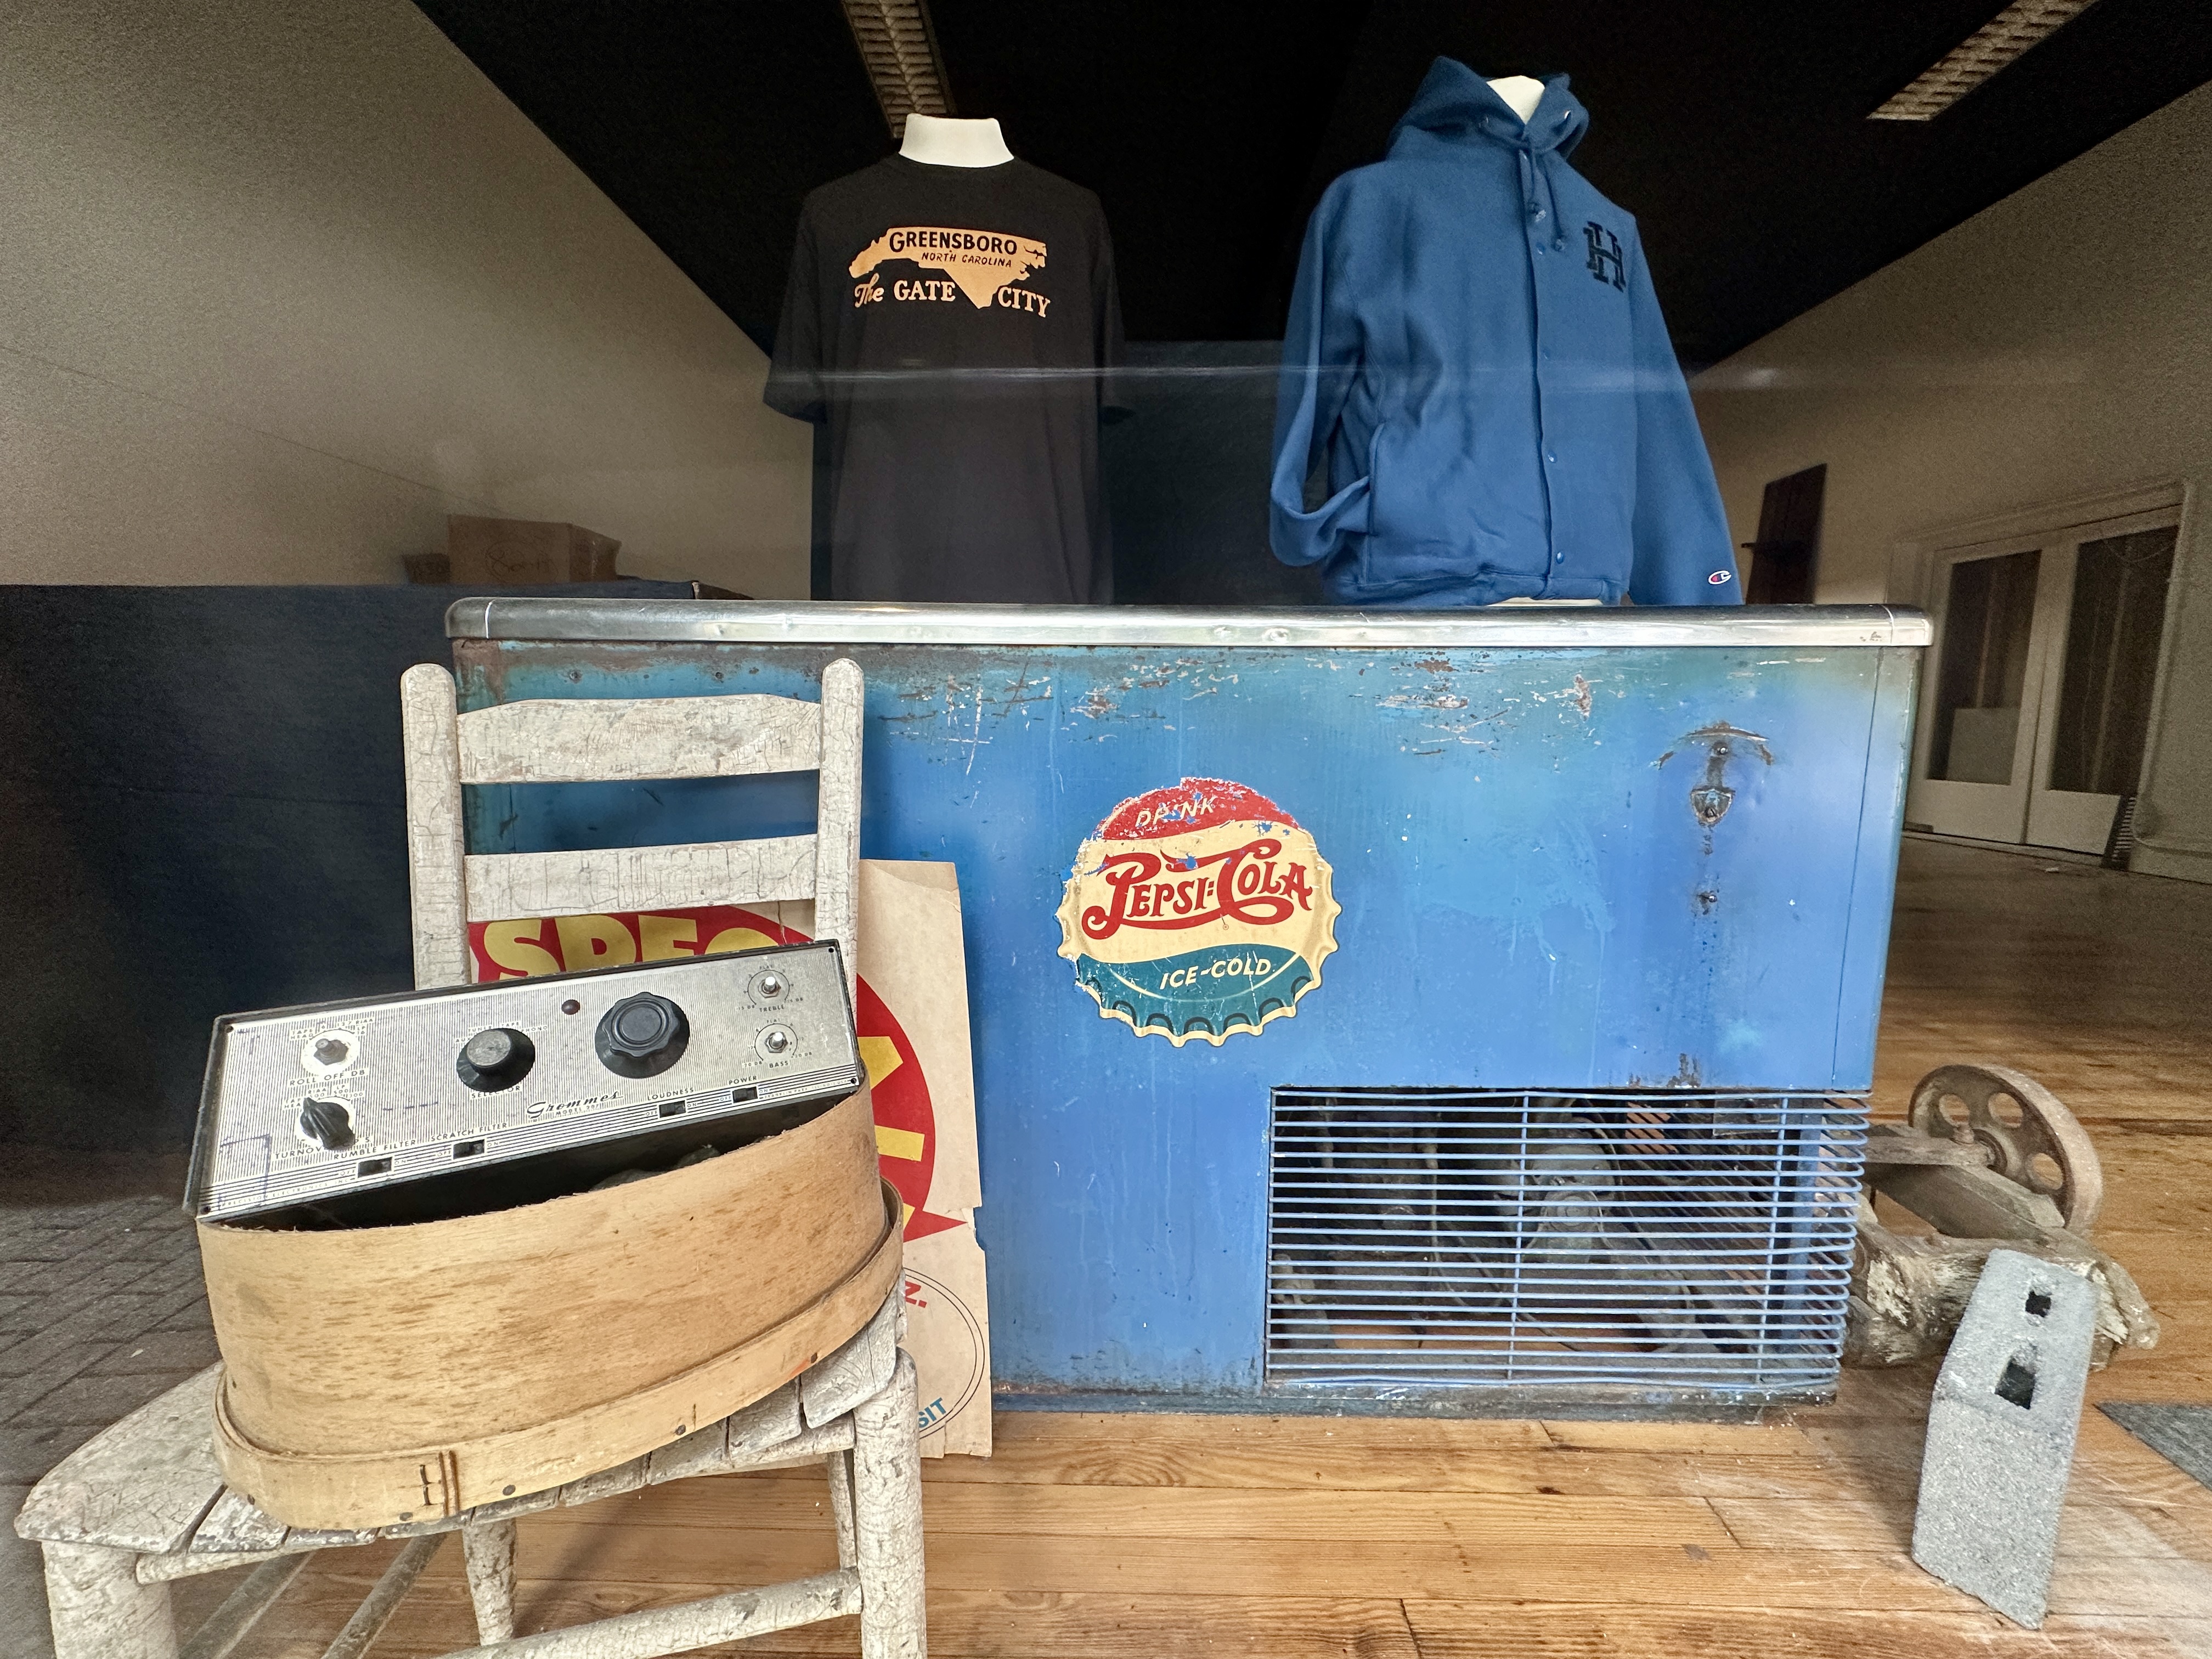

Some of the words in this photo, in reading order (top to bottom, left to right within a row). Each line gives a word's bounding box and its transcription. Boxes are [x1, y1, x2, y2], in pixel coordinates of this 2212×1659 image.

[889, 231, 1017, 255] GREENSBORO
[921, 251, 956, 262] NORTH
[962, 255, 1012, 268] CAROLINA
[854, 273, 884, 308] The
[893, 280, 956, 302] GATE
[997, 285, 1051, 318] CITY
[1135, 796, 1217, 827] DRNK
[1159, 958, 1271, 990] ICE-COLD
[759, 1004, 785, 1013] TREBLE
[290, 1077, 317, 1086] ROLL
[324, 1073, 344, 1081] OFF
[729, 1075, 757, 1085] POWER
[647, 1087, 695, 1101] LOUDNESS
[527, 1091, 624, 1119] Grommes
[431, 1128, 474, 1142] SCRATCH
[479, 1122, 507, 1133] FILTER
[275, 1146, 322, 1159] TURNOV
[334, 1146, 377, 1160] RUMBLE
[384, 1139, 416, 1150] FILTER
